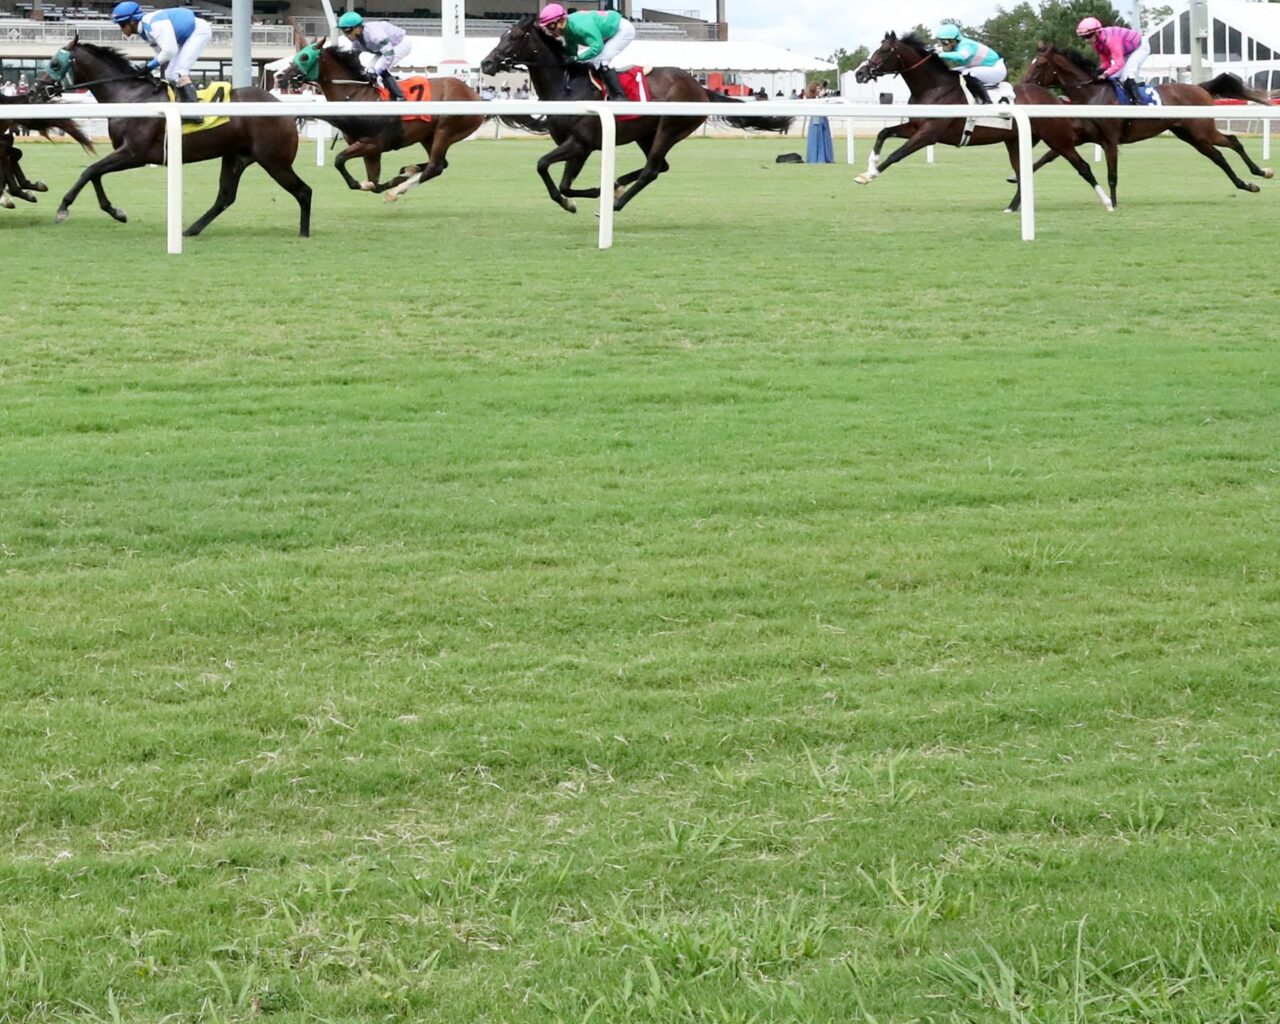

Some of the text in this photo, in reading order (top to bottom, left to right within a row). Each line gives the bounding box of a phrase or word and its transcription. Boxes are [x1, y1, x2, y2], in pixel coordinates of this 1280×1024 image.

[409, 84, 424, 102] 7
[635, 71, 647, 102] 1
[1145, 87, 1162, 106] 3
